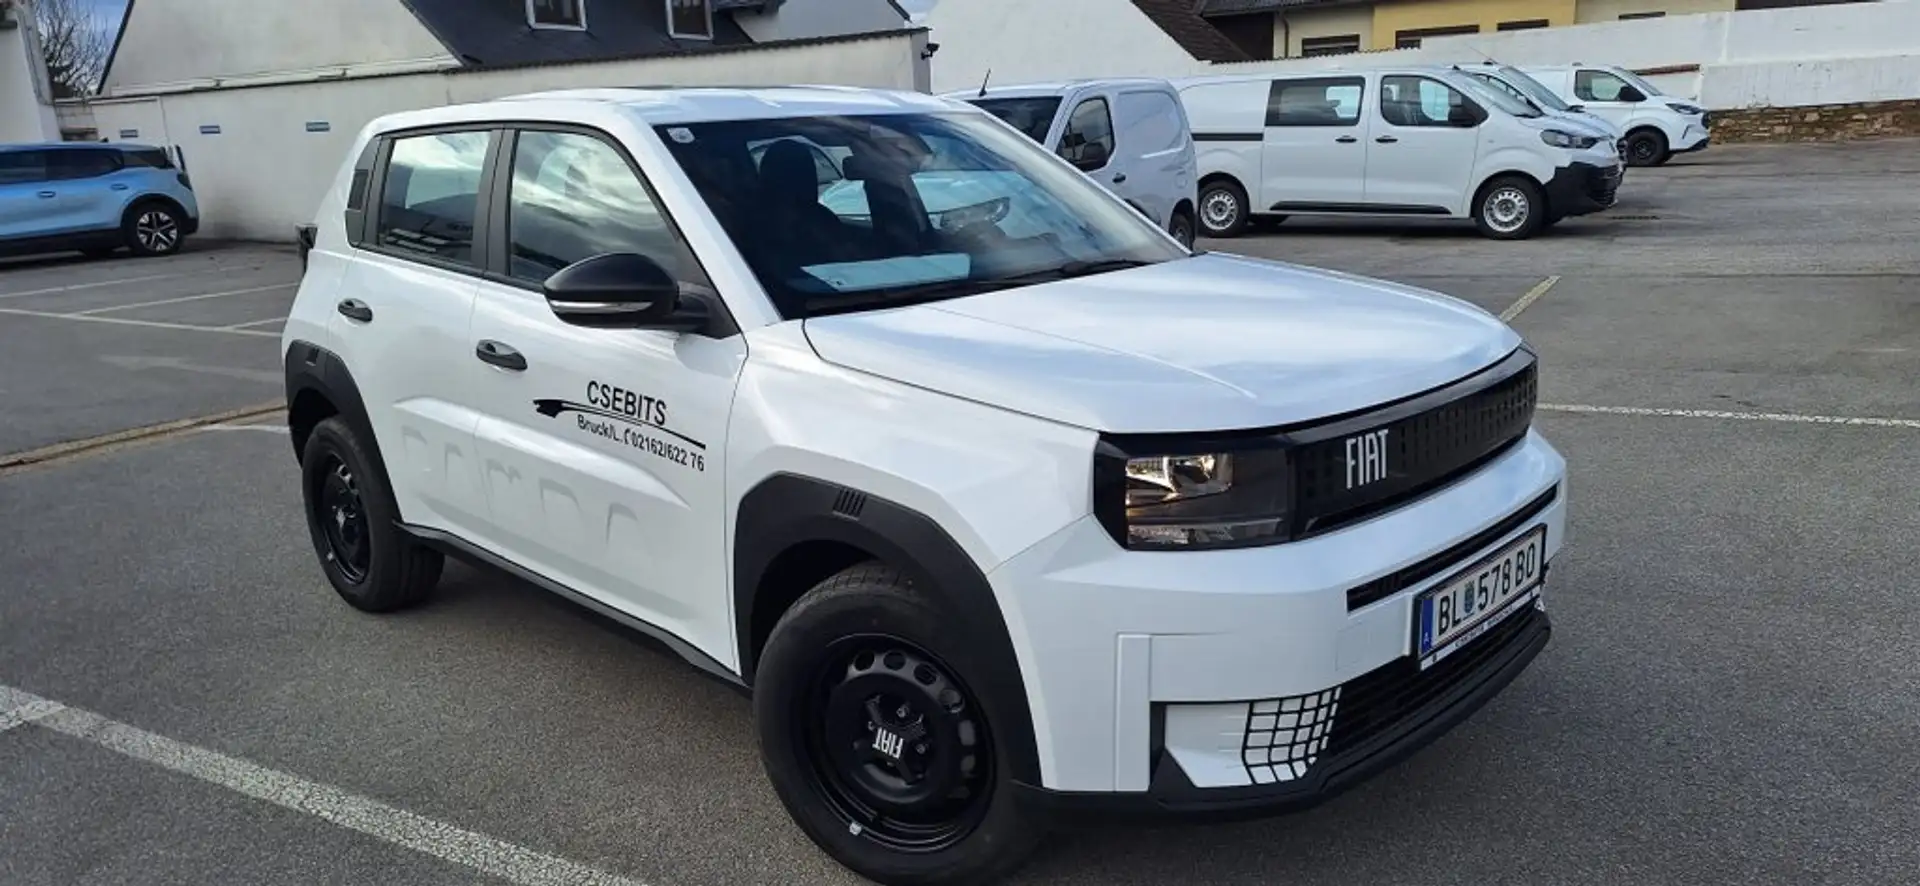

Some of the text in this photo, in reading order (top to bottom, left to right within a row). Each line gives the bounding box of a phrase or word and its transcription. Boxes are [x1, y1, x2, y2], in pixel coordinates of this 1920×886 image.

[587, 380, 667, 425] CSEBITS
[631, 430, 687, 466] 02162/622
[690, 452, 705, 472] 76
[1346, 429, 1389, 489] FIAT
[1438, 590, 1461, 636] BL
[1478, 558, 1512, 611] 578
[872, 727, 904, 759] FIAT
